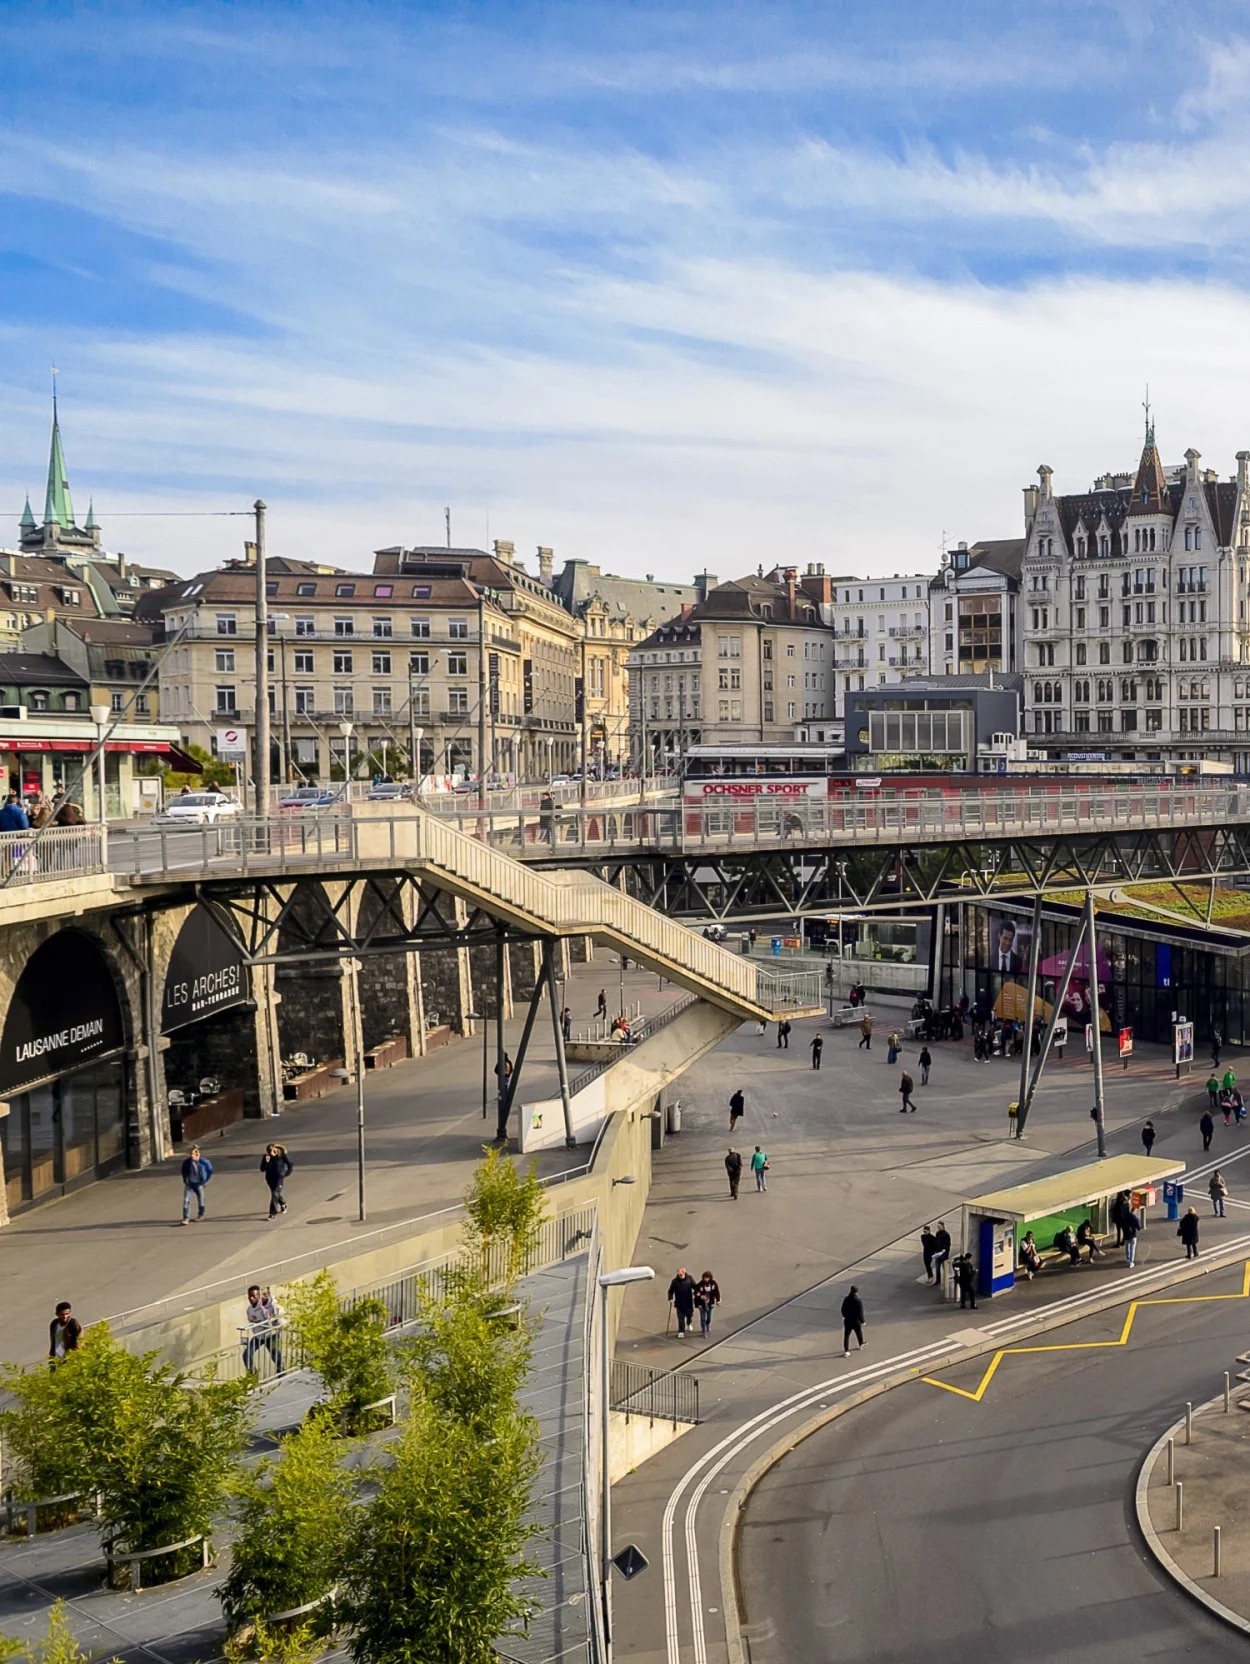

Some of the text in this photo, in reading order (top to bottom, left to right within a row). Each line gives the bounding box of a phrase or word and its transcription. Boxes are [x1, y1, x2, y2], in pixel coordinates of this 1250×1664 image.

[702, 784, 809, 794] OCHSNER SPORT
[166, 964, 240, 1008] LES ARCHES!
[16, 1018, 104, 1062] LAUSANNE DEMAIN
